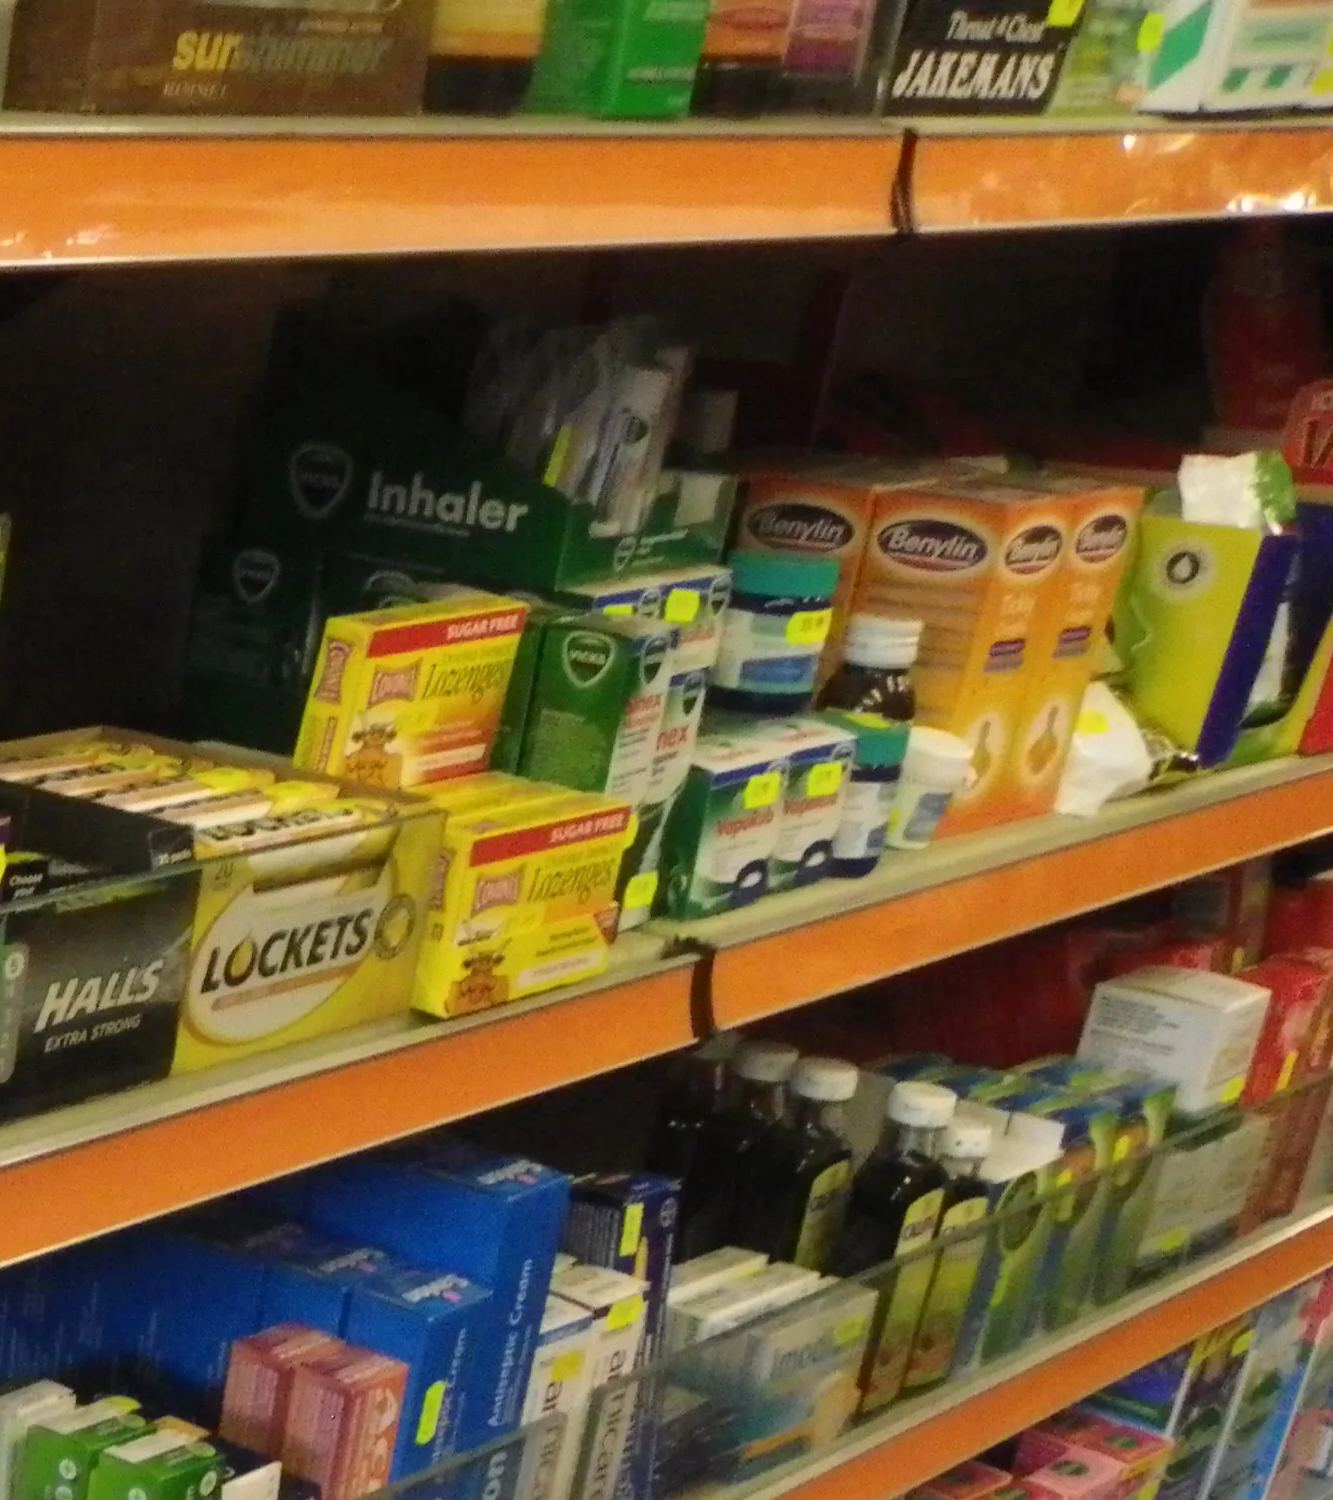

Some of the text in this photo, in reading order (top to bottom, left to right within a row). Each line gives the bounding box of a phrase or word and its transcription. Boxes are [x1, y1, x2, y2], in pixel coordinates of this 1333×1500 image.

[891, 50, 1055, 100] JAKEMANS
[363, 470, 531, 534] Inhaler
[758, 510, 846, 543] Benylin
[889, 526, 986, 563] Benylin
[446, 615, 518, 640] SUGAR FREE
[422, 659, 504, 702] Lozenges
[550, 815, 624, 844] SUGAR FREE
[527, 857, 615, 902] Lozenges
[199, 907, 373, 995] LOCKETS
[34, 959, 165, 1034] HALLS
[44, 1013, 142, 1053] EXTRA STRONG
[509, 1257, 535, 1326] Cream
